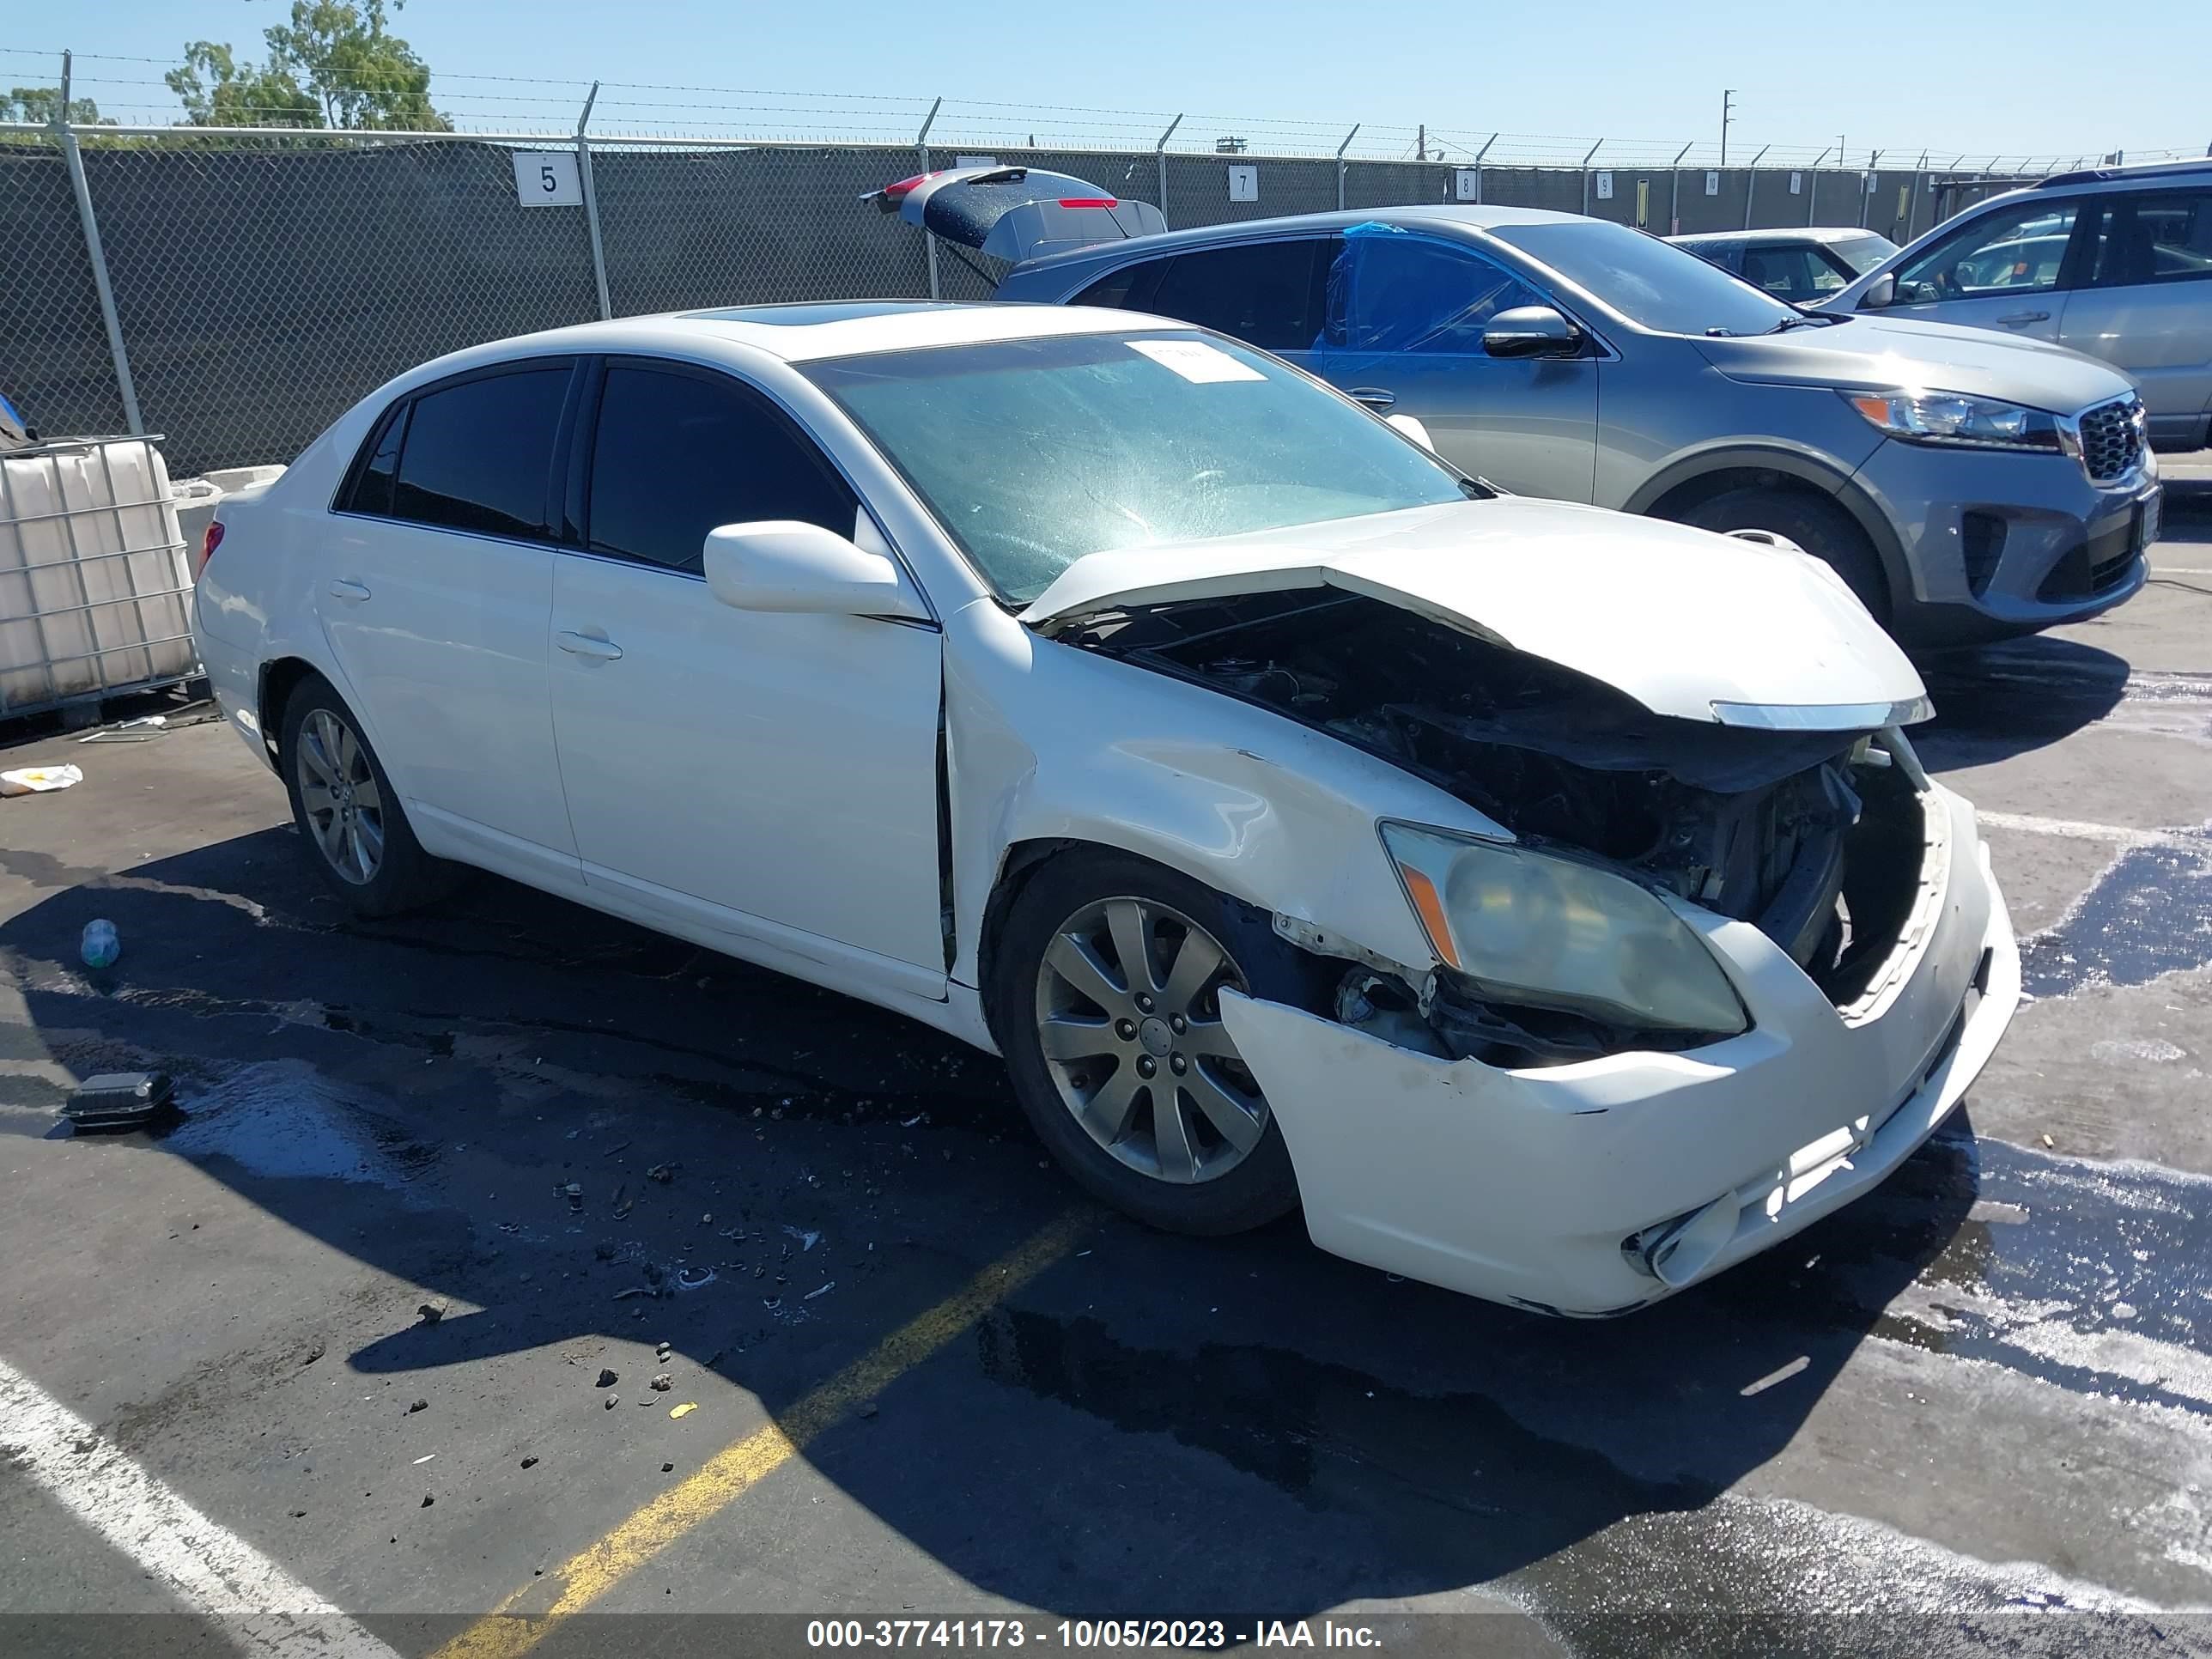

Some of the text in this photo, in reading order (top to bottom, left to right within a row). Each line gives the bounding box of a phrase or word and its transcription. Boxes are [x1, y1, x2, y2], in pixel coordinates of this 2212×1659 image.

[541, 166, 556, 192] 5
[1239, 174, 1247, 192] 7
[1463, 177, 1470, 193] 8
[1602, 179, 1608, 192] 9
[1709, 178, 1716, 191] 10
